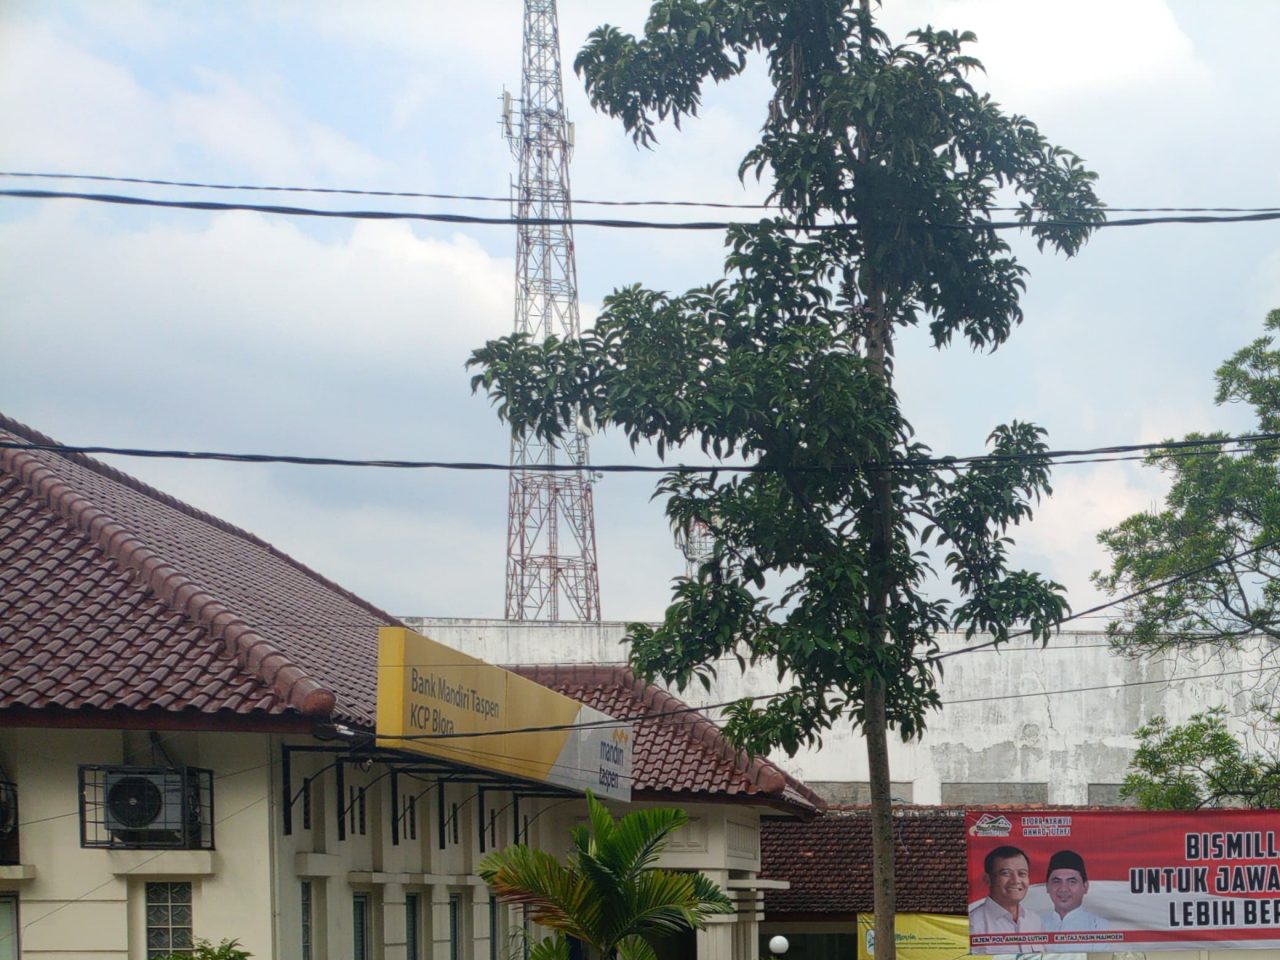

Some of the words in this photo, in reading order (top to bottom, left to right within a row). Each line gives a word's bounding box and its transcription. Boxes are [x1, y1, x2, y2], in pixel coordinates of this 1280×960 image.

[410, 667, 436, 698] Bank
[438, 679, 471, 710] Mandiri
[471, 690, 500, 721] Taspen
[410, 703, 430, 730] KCP
[431, 710, 454, 736] Blora
[600, 740, 625, 767] mandiri
[599, 765, 619, 792] taspen
[1129, 865, 1209, 895] UNTUK
[1169, 899, 1236, 927] LEBIH
[1005, 935, 1027, 943] AHMAD
